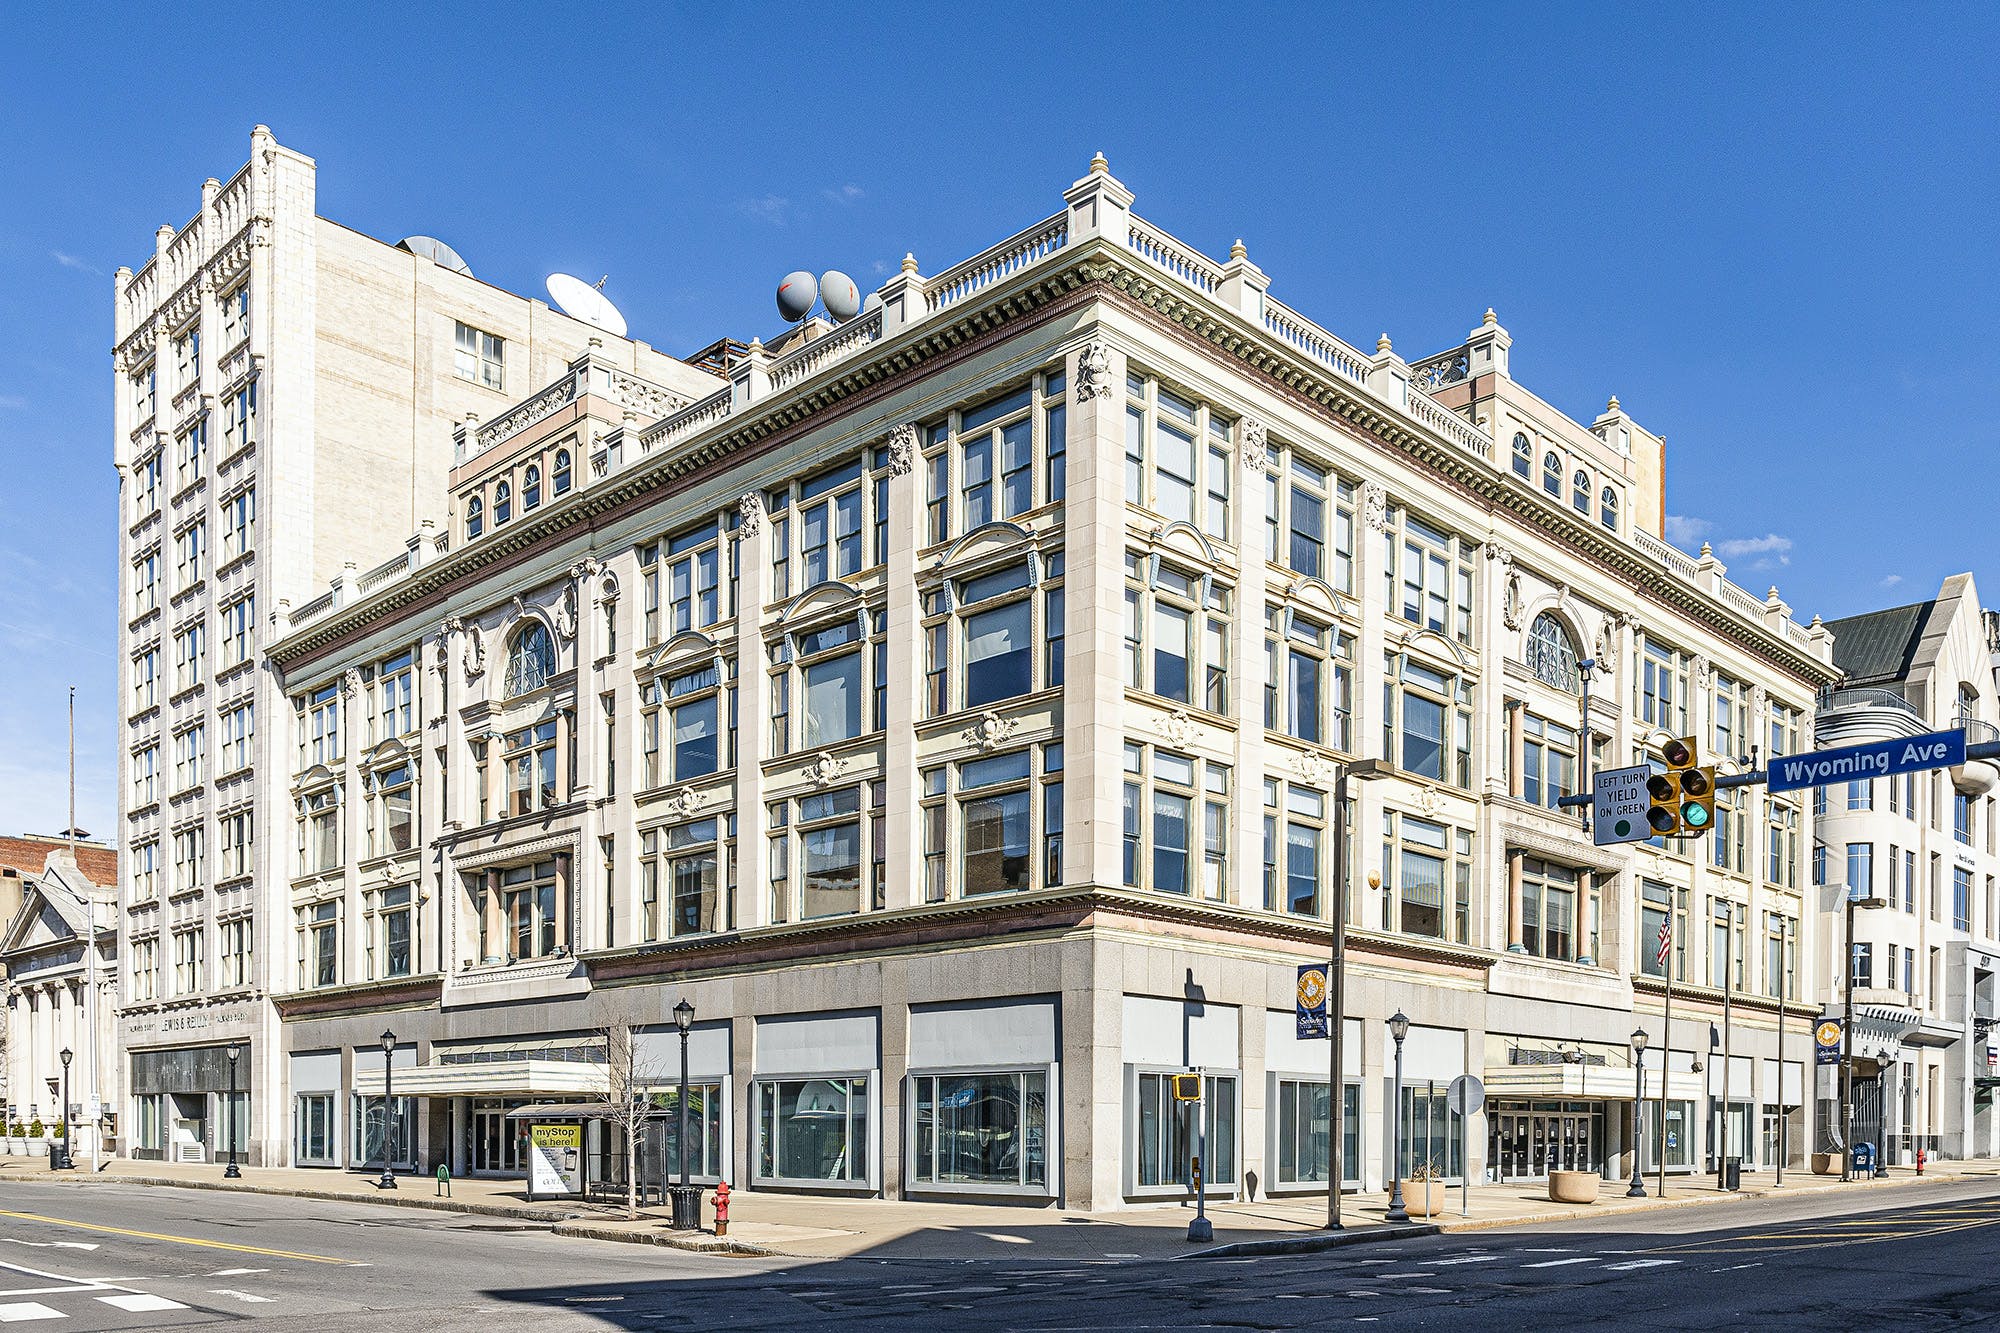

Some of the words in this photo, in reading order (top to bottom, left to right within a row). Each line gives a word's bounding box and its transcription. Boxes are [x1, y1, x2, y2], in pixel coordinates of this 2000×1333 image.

[1784, 751, 1889, 783] Wyoming
[1901, 743, 1947, 764] Ave
[1598, 777, 1618, 789] LEFT
[1621, 772, 1646, 785] TURN
[1606, 788, 1638, 803] YIELD
[1600, 807, 1612, 818] ON
[1616, 803, 1645, 816] GREEN
[536, 1127, 575, 1137] myStop
[540, 1137, 547, 1146] is
[550, 1137, 574, 1146] here!
